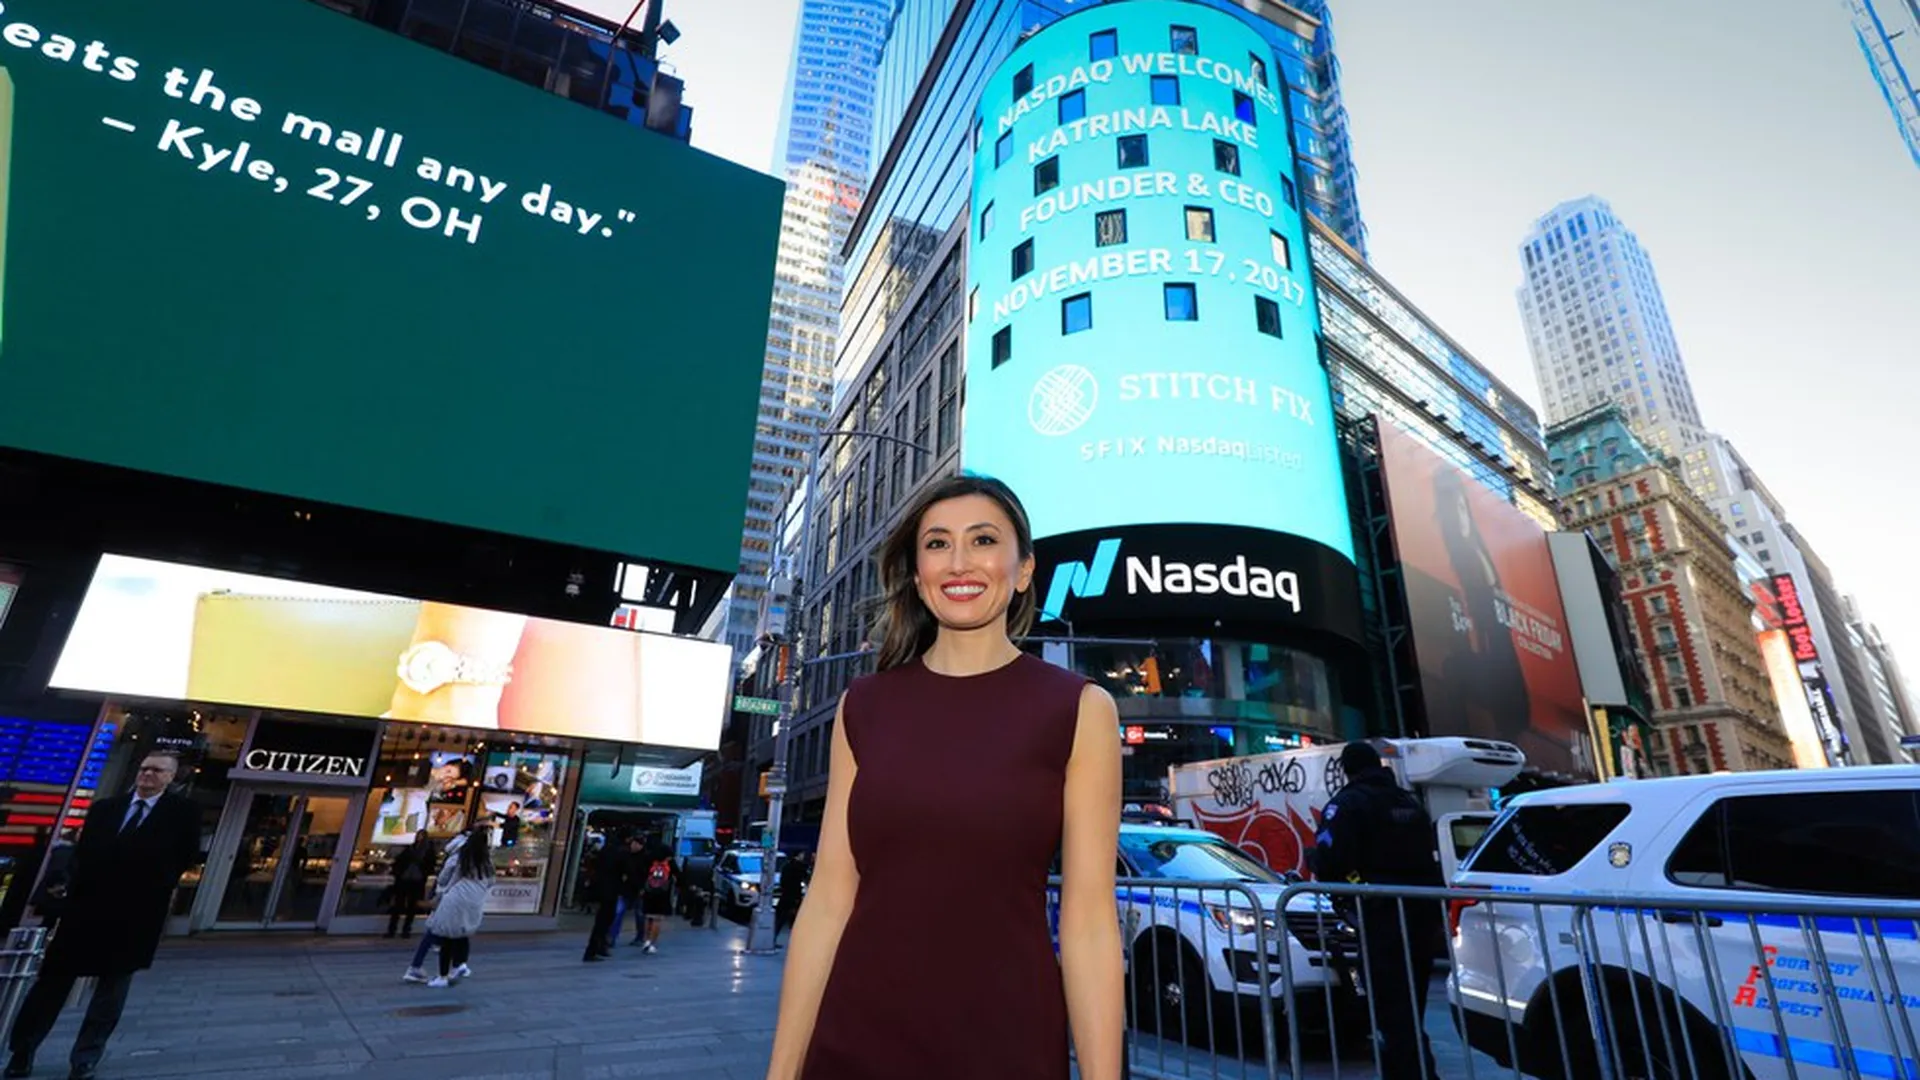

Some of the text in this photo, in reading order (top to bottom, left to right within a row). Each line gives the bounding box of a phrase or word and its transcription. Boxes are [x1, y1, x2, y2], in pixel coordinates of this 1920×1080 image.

[998, 52, 1279, 133] NASDAQ WELCOMES
[3, 22, 636, 238] eats the mall any day."
[1028, 107, 1260, 164] KATRINA LAKE
[156, 118, 289, 193] Kyle,
[306, 167, 382, 221] 27,
[400, 195, 483, 244] OH
[1020, 171, 1274, 232] FOUNDER & CEO
[992, 248, 1305, 323] NOVEMBER 17, 2017
[1118, 371, 1315, 427] STITCH FIX
[1126, 555, 1301, 614] Nasdaq
[1788, 626, 1817, 660] Foot
[245, 749, 366, 777] CITIZEN
[1761, 945, 1860, 976] COURESY
[1734, 985, 1823, 1017] REPECT
